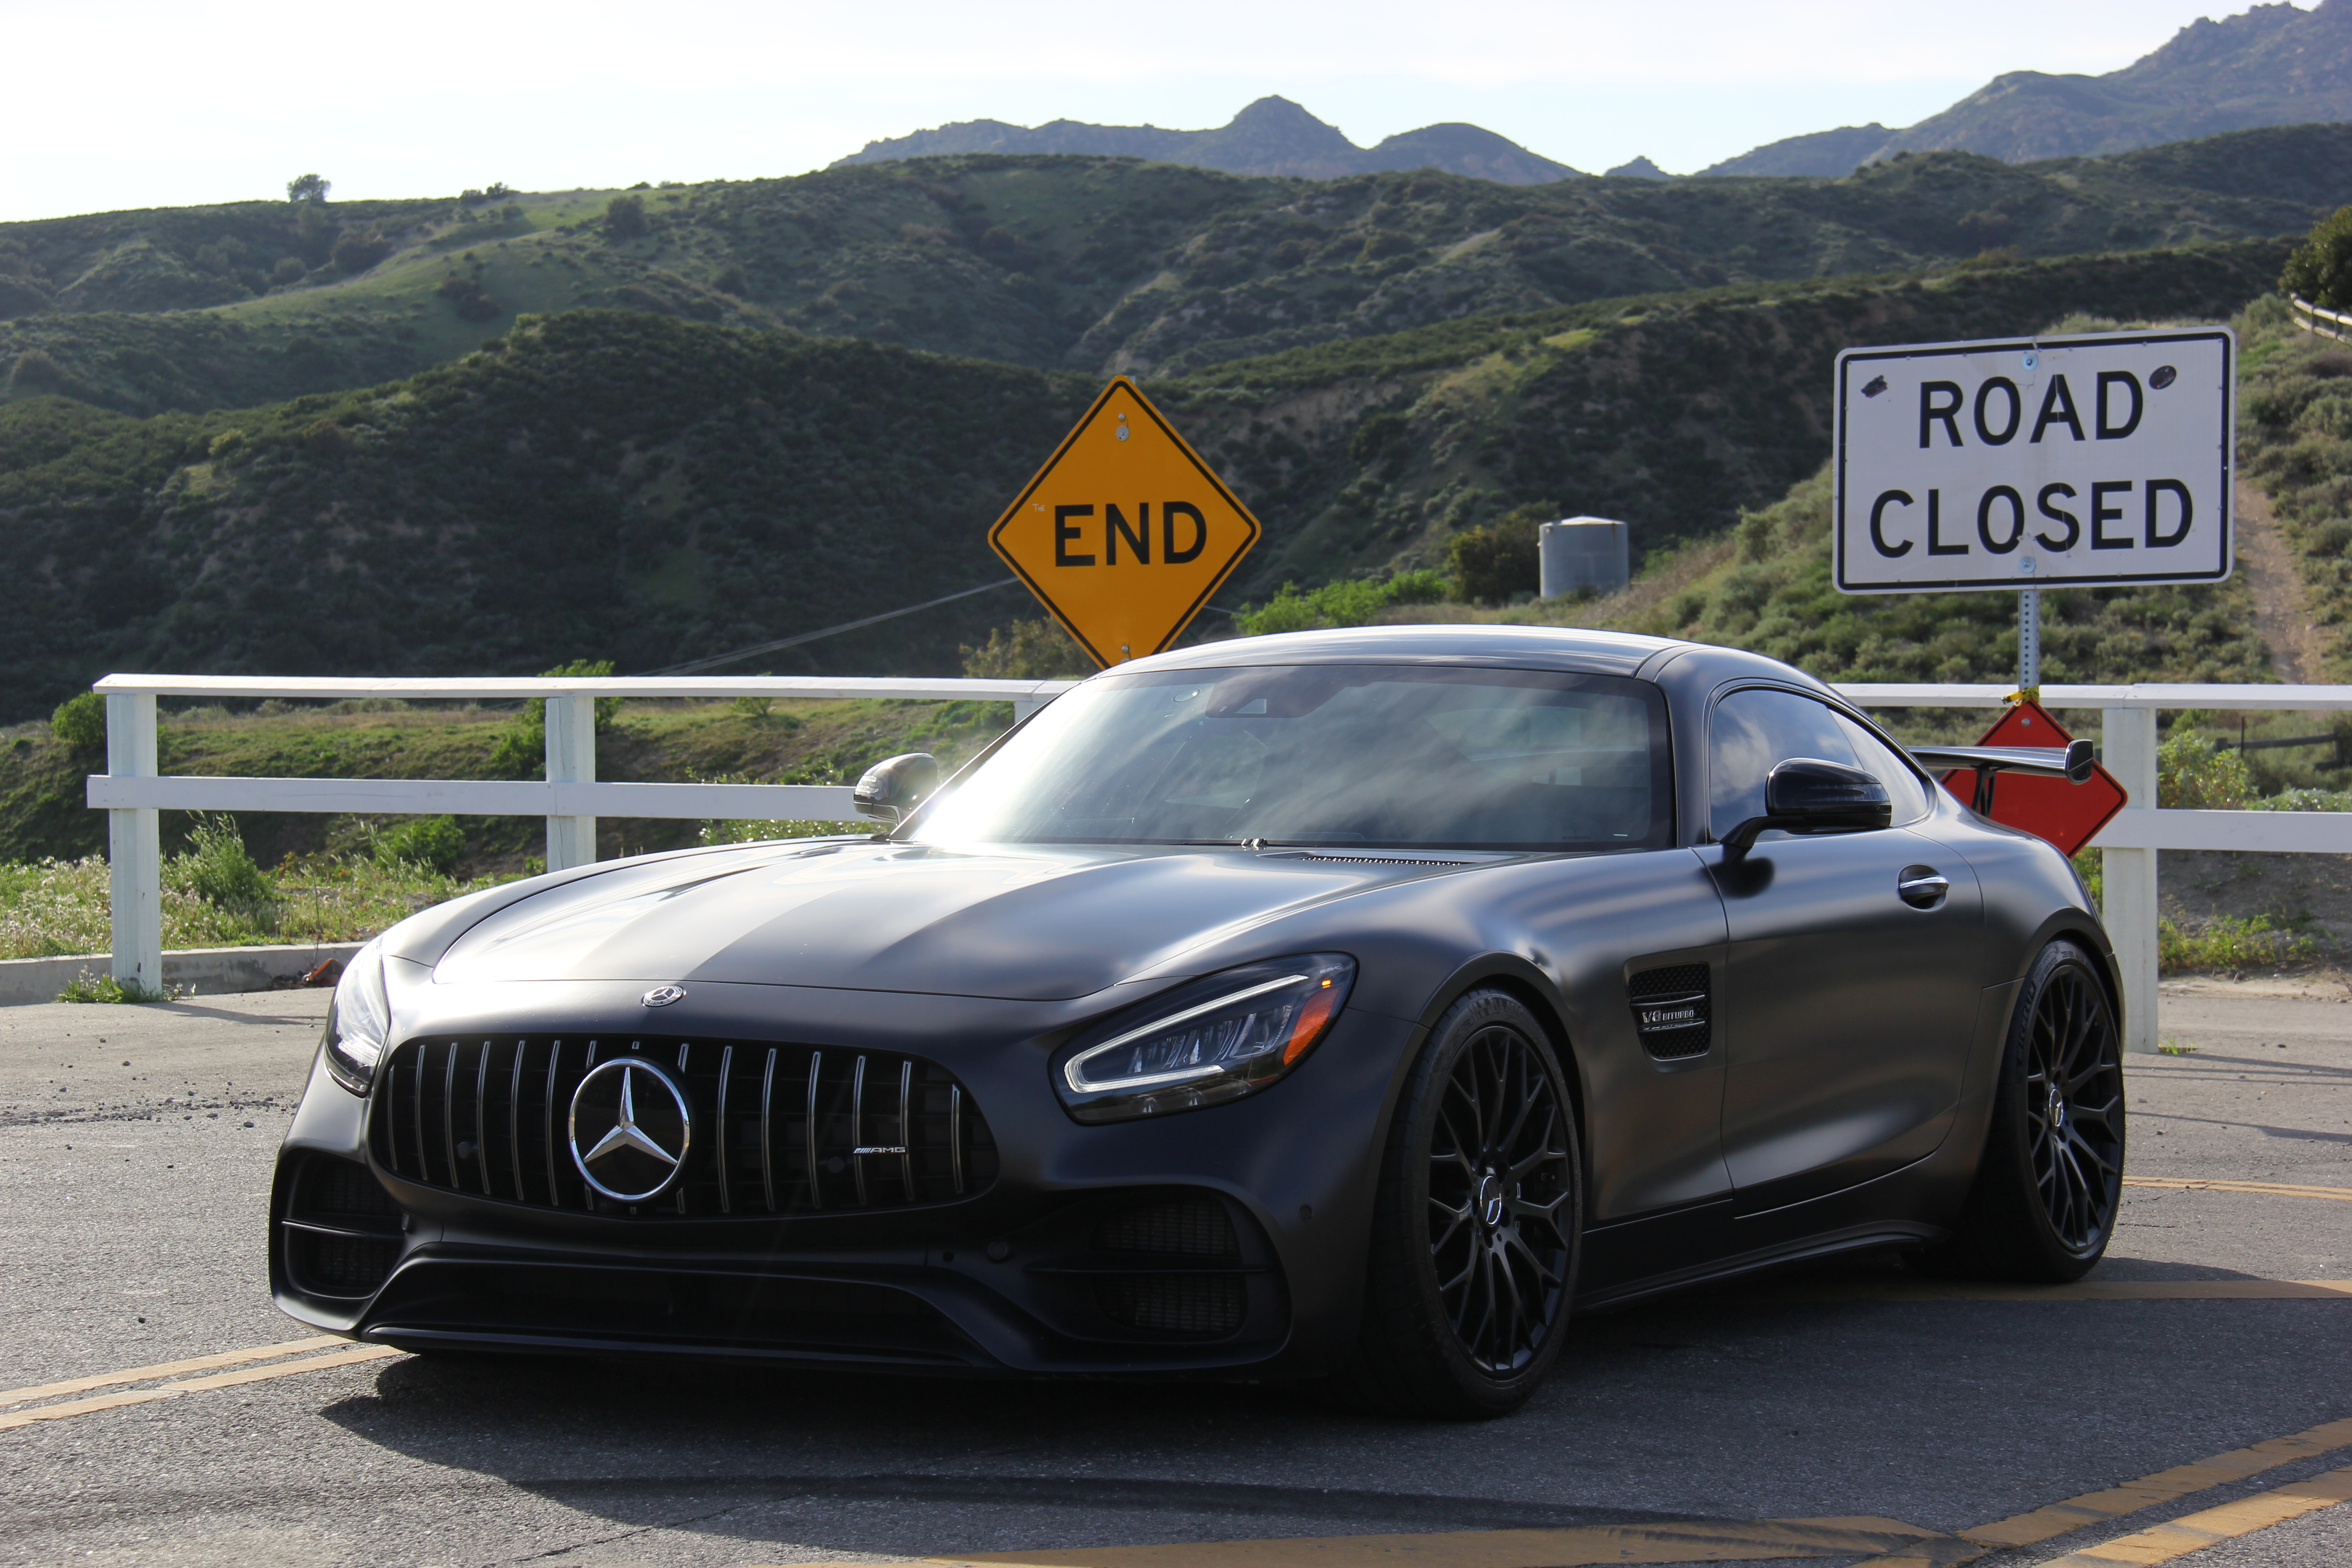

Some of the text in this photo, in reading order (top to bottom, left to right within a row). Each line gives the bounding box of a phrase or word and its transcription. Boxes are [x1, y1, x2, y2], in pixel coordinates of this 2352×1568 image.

[1919, 371, 2143, 449] ROAD
[1032, 503, 1045, 512] THE
[1054, 501, 1207, 567] END
[1869, 478, 2193, 559] CLOSED
[1642, 1009, 1694, 1023] V8 BITURBO
